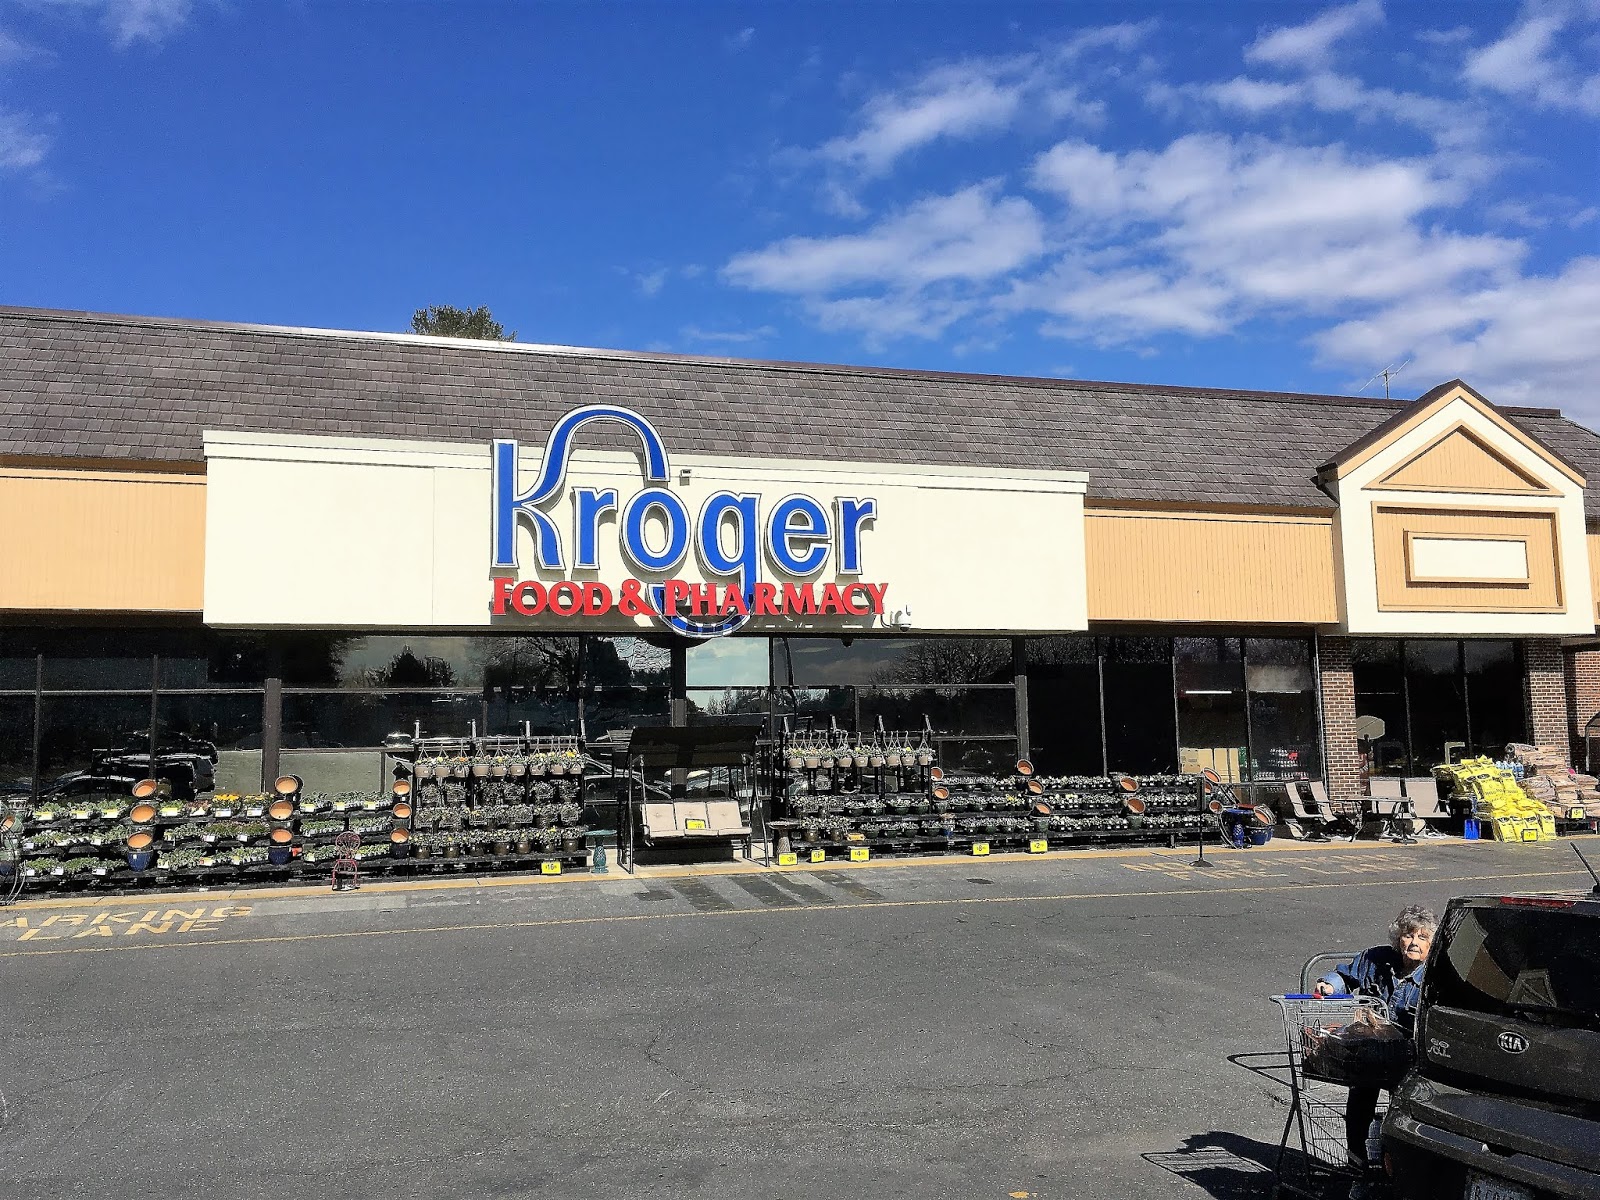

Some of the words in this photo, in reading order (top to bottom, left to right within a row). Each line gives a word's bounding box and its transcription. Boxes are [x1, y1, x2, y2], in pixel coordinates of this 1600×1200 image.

[491, 404, 878, 639] Kroger
[491, 577, 612, 616] FOOD
[618, 577, 660, 617] &
[663, 579, 889, 617] PHARMACY
[0, 905, 253, 928] ARKING
[17, 918, 227, 942] LANE
[1500, 1034, 1523, 1051] KIA
